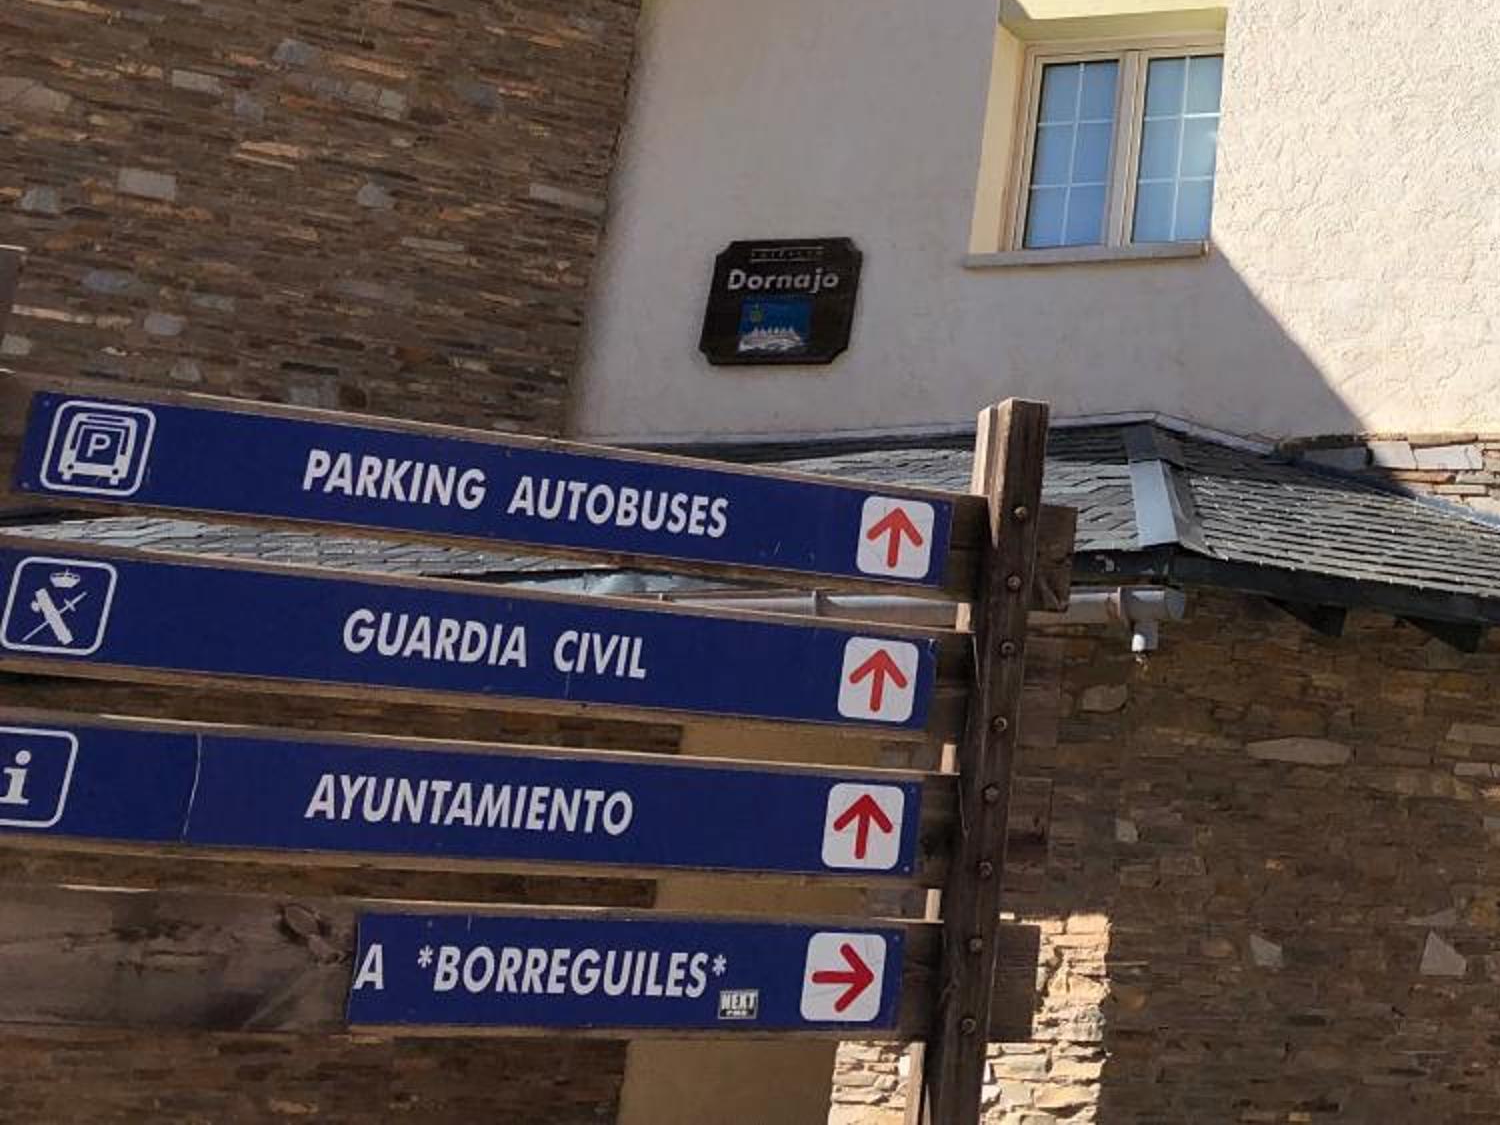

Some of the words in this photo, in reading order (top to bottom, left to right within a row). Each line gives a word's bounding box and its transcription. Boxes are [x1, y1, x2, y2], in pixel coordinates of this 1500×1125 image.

[727, 268, 840, 294] Dornajo
[303, 449, 486, 510] PARKING
[507, 475, 729, 538] AUTOBUSES
[343, 608, 527, 668] GUARDIA
[553, 630, 647, 679] CIVIL
[304, 774, 633, 836] AYUNTAMIENTO
[353, 943, 384, 990] A
